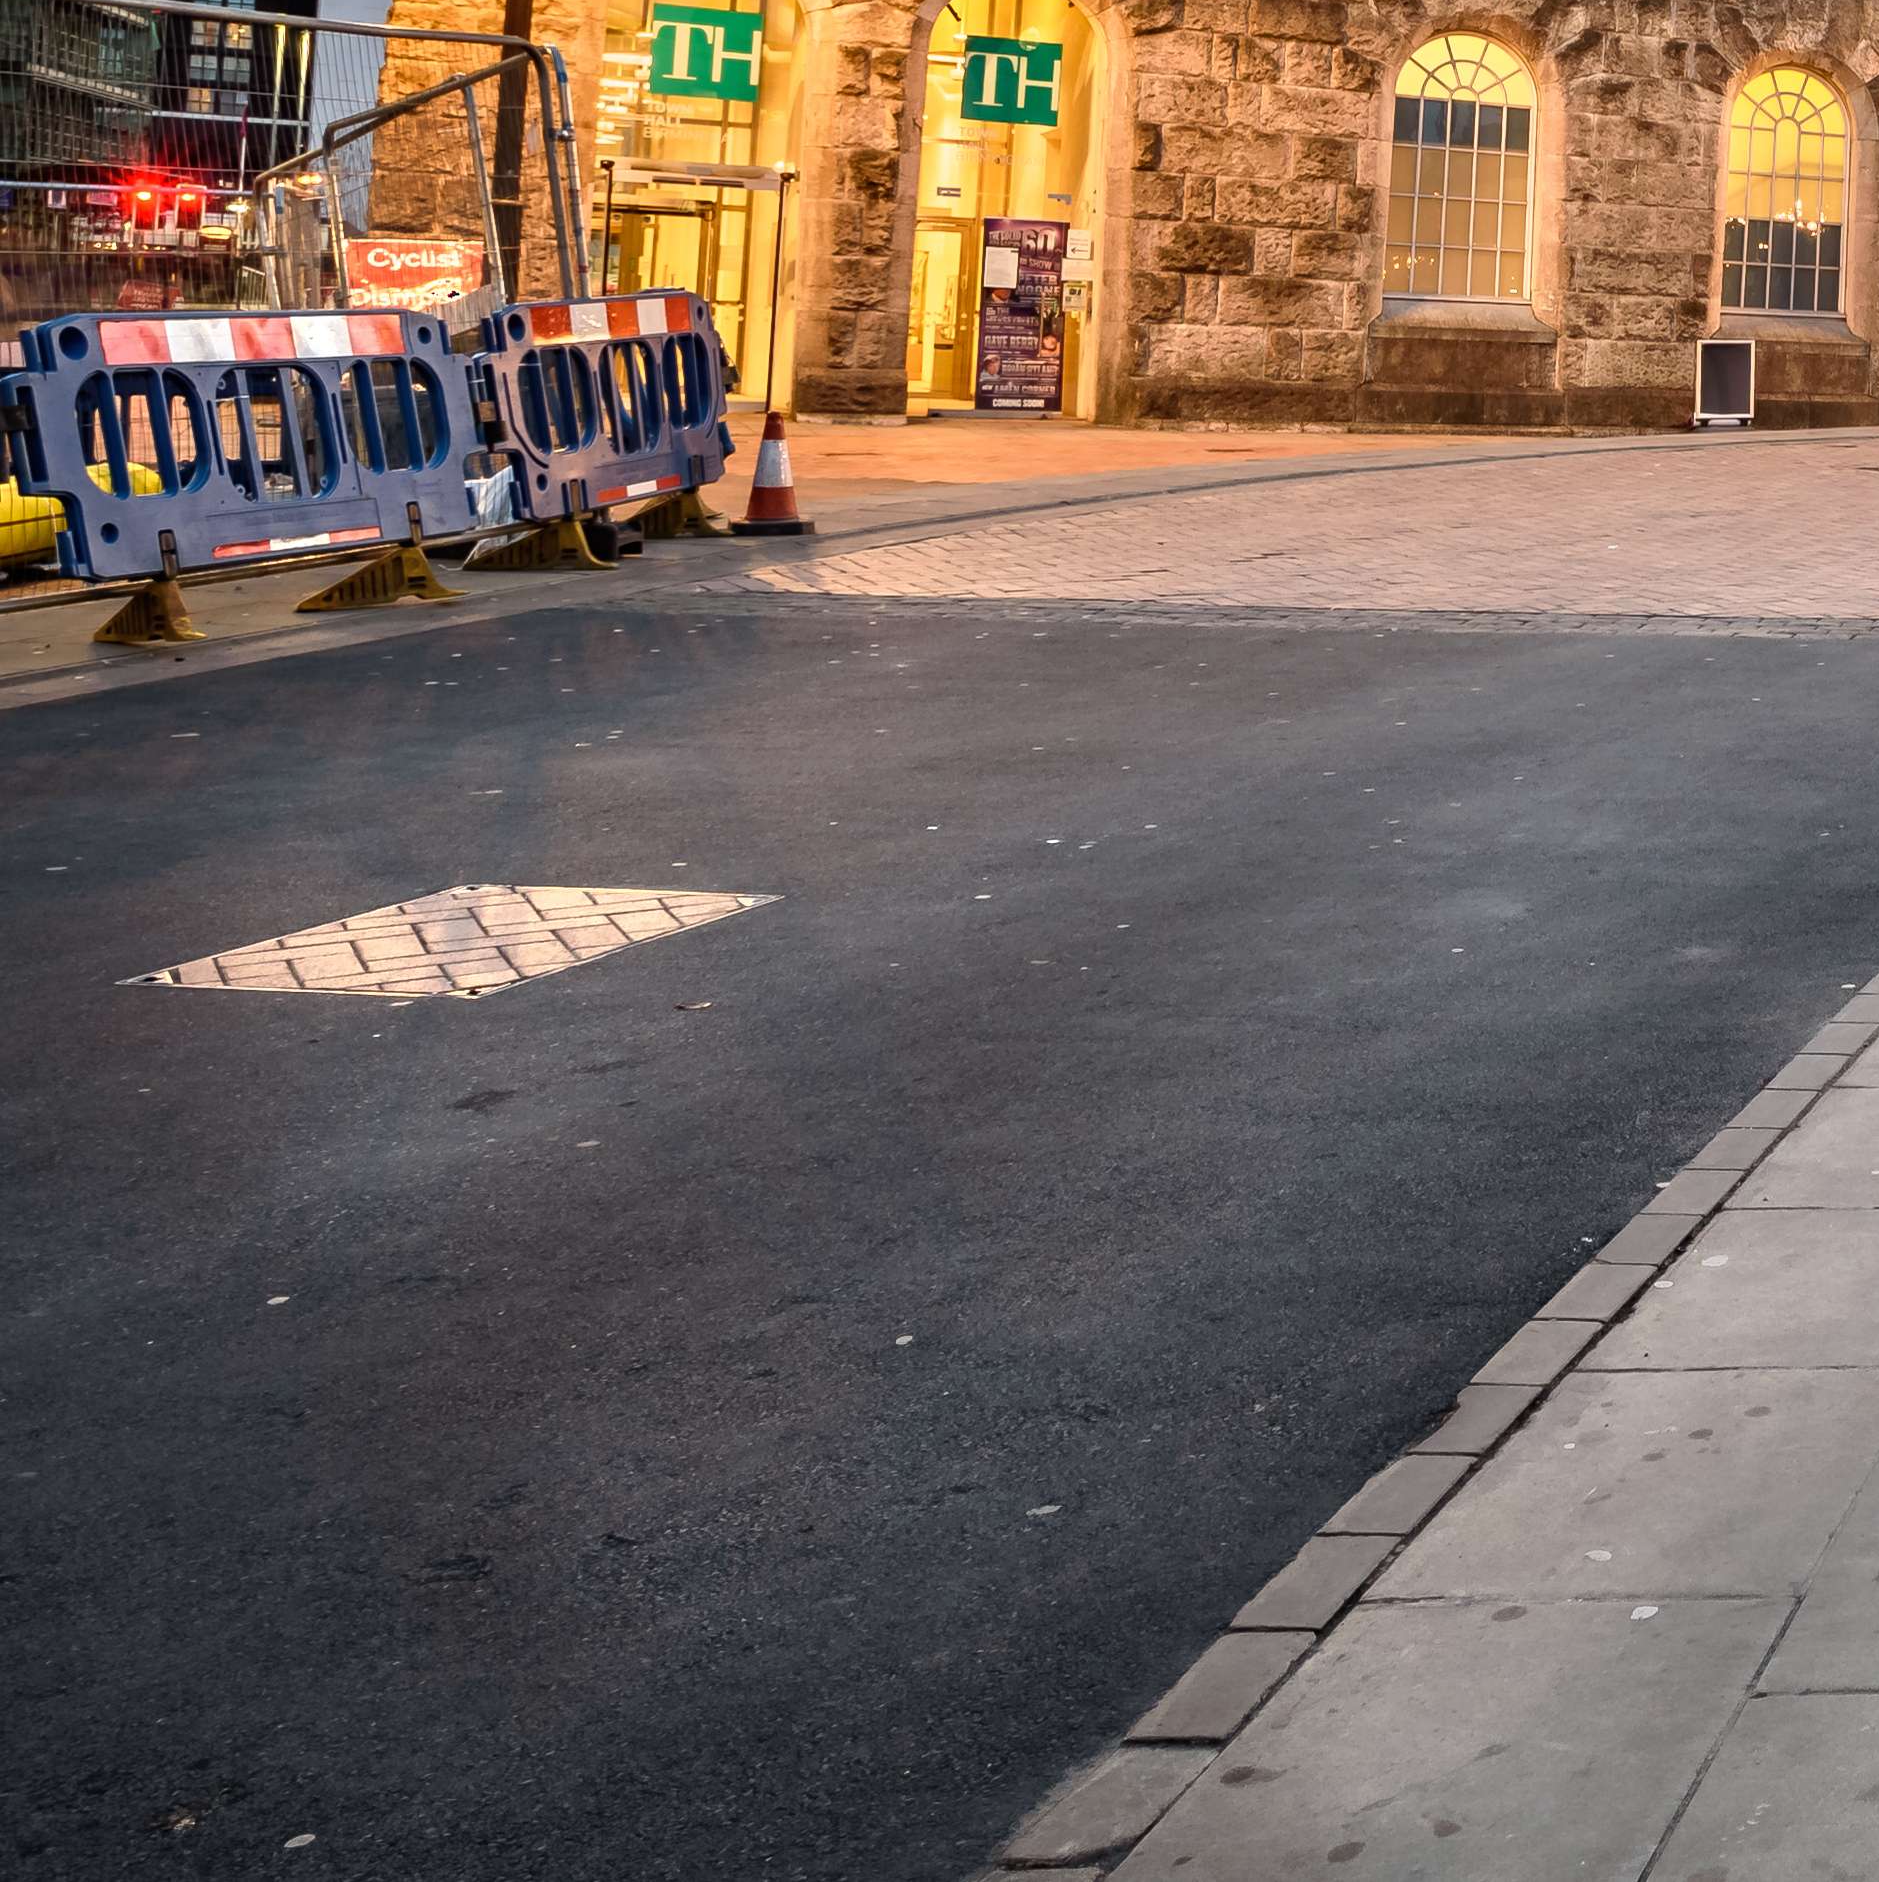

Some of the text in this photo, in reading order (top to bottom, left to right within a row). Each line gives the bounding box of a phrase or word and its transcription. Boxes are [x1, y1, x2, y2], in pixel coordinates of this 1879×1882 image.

[652, 20, 762, 86] TH
[965, 51, 1061, 112] TH
[992, 398, 1022, 408] COMING
